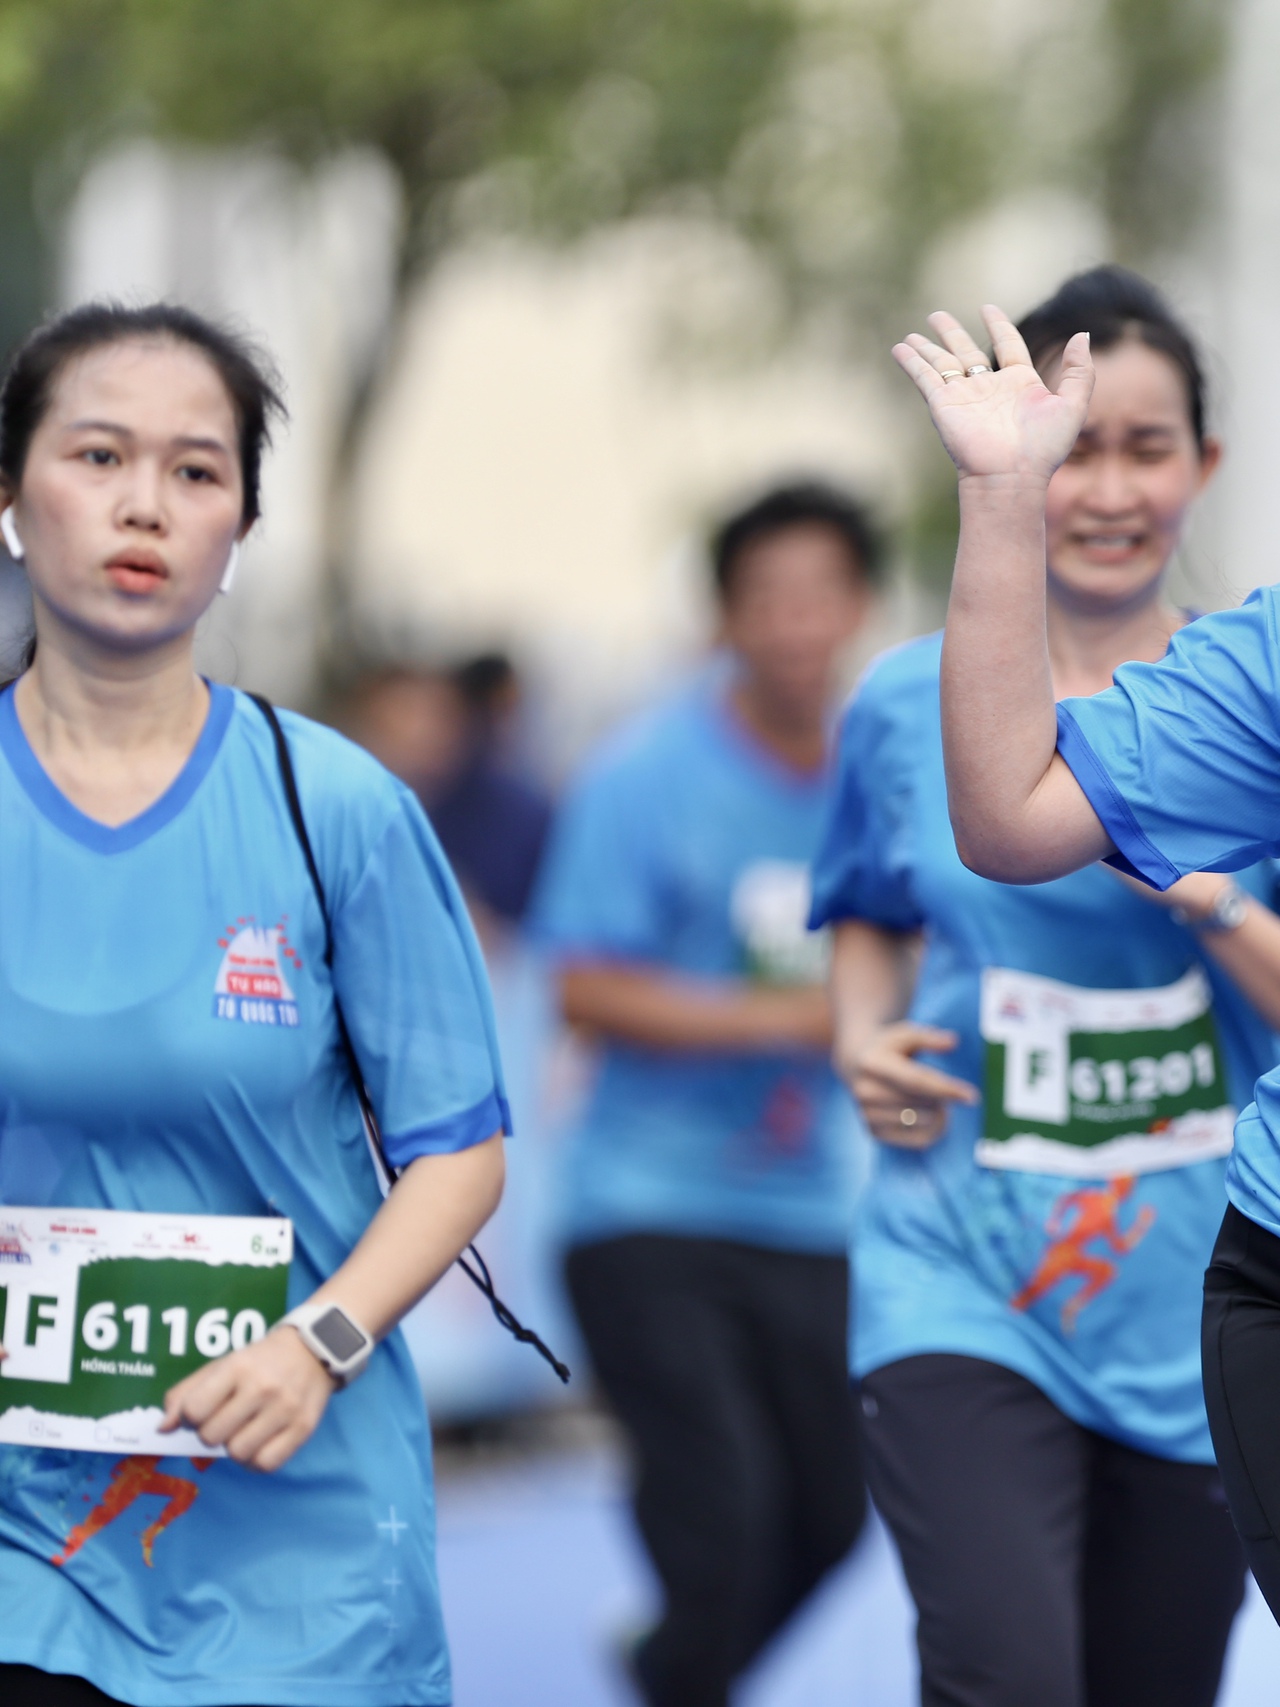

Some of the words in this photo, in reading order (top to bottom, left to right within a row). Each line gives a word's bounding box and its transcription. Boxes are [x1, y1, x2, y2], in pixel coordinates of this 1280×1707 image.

[1025, 1047, 1055, 1090] F
[1069, 1041, 1216, 1103] 61201
[250, 1234, 263, 1254] 6
[24, 1293, 59, 1348] F
[81, 1301, 268, 1358] 61160
